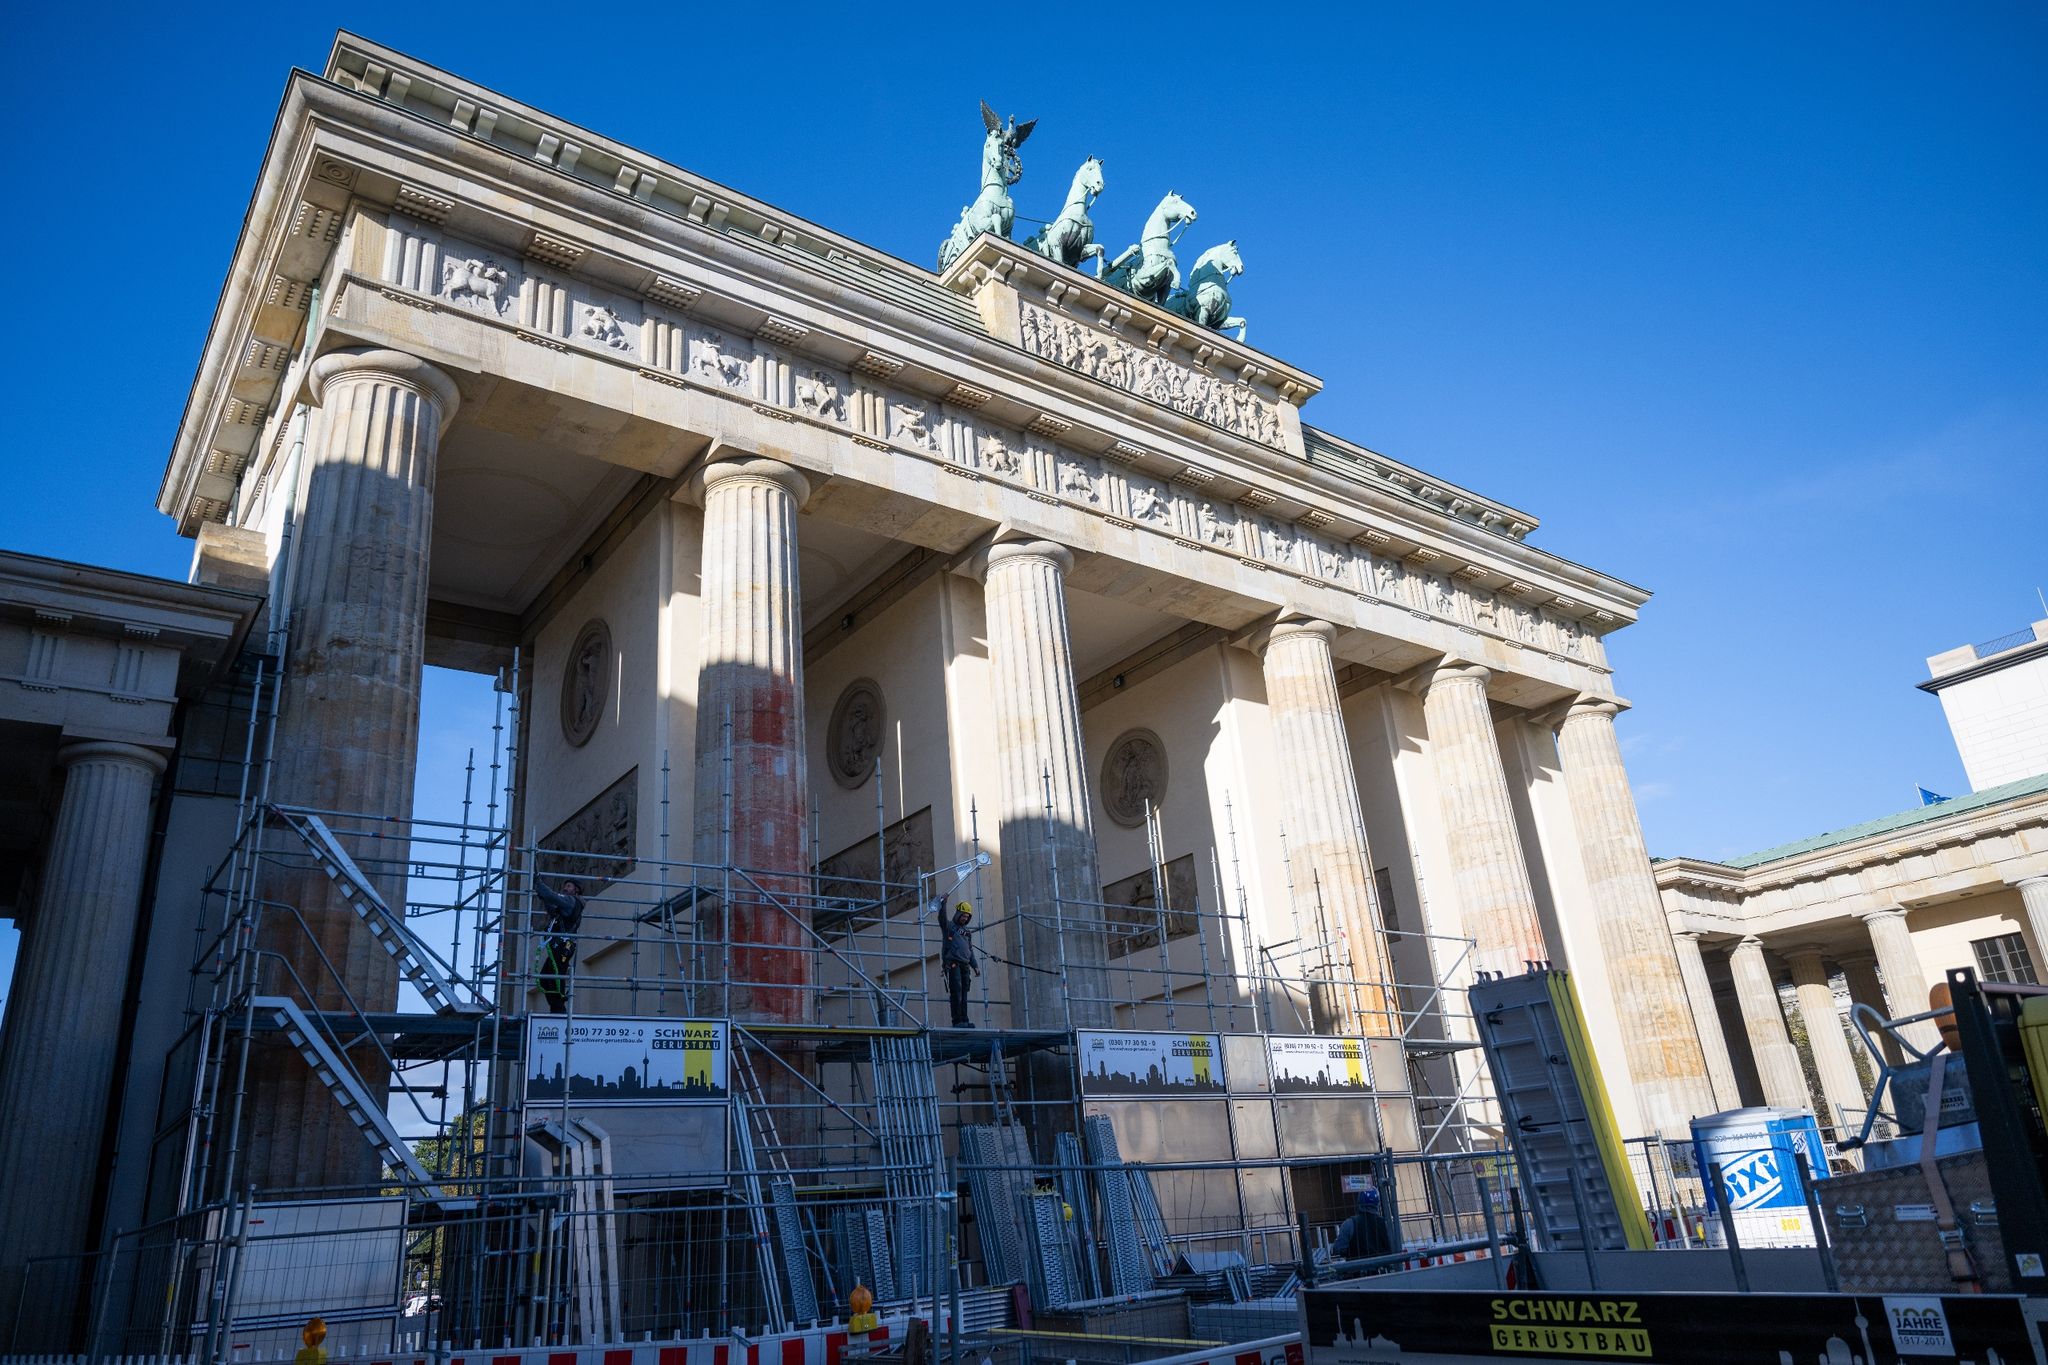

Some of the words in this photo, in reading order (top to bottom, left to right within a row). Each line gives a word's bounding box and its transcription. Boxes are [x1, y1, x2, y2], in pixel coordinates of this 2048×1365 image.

[592, 1028, 602, 1036] 77
[605, 1028, 617, 1036] 30
[619, 1028, 630, 1037] 92
[638, 1029, 644, 1037] 0
[655, 1029, 720, 1038] SCHWARZ
[1490, 1299, 1642, 1323] SCHWARZ
[1896, 1318, 1943, 1328] JAHRE
[1496, 1329, 1646, 1352] GERÜSTBAU
[1898, 1336, 1945, 1345] 1917-2017
